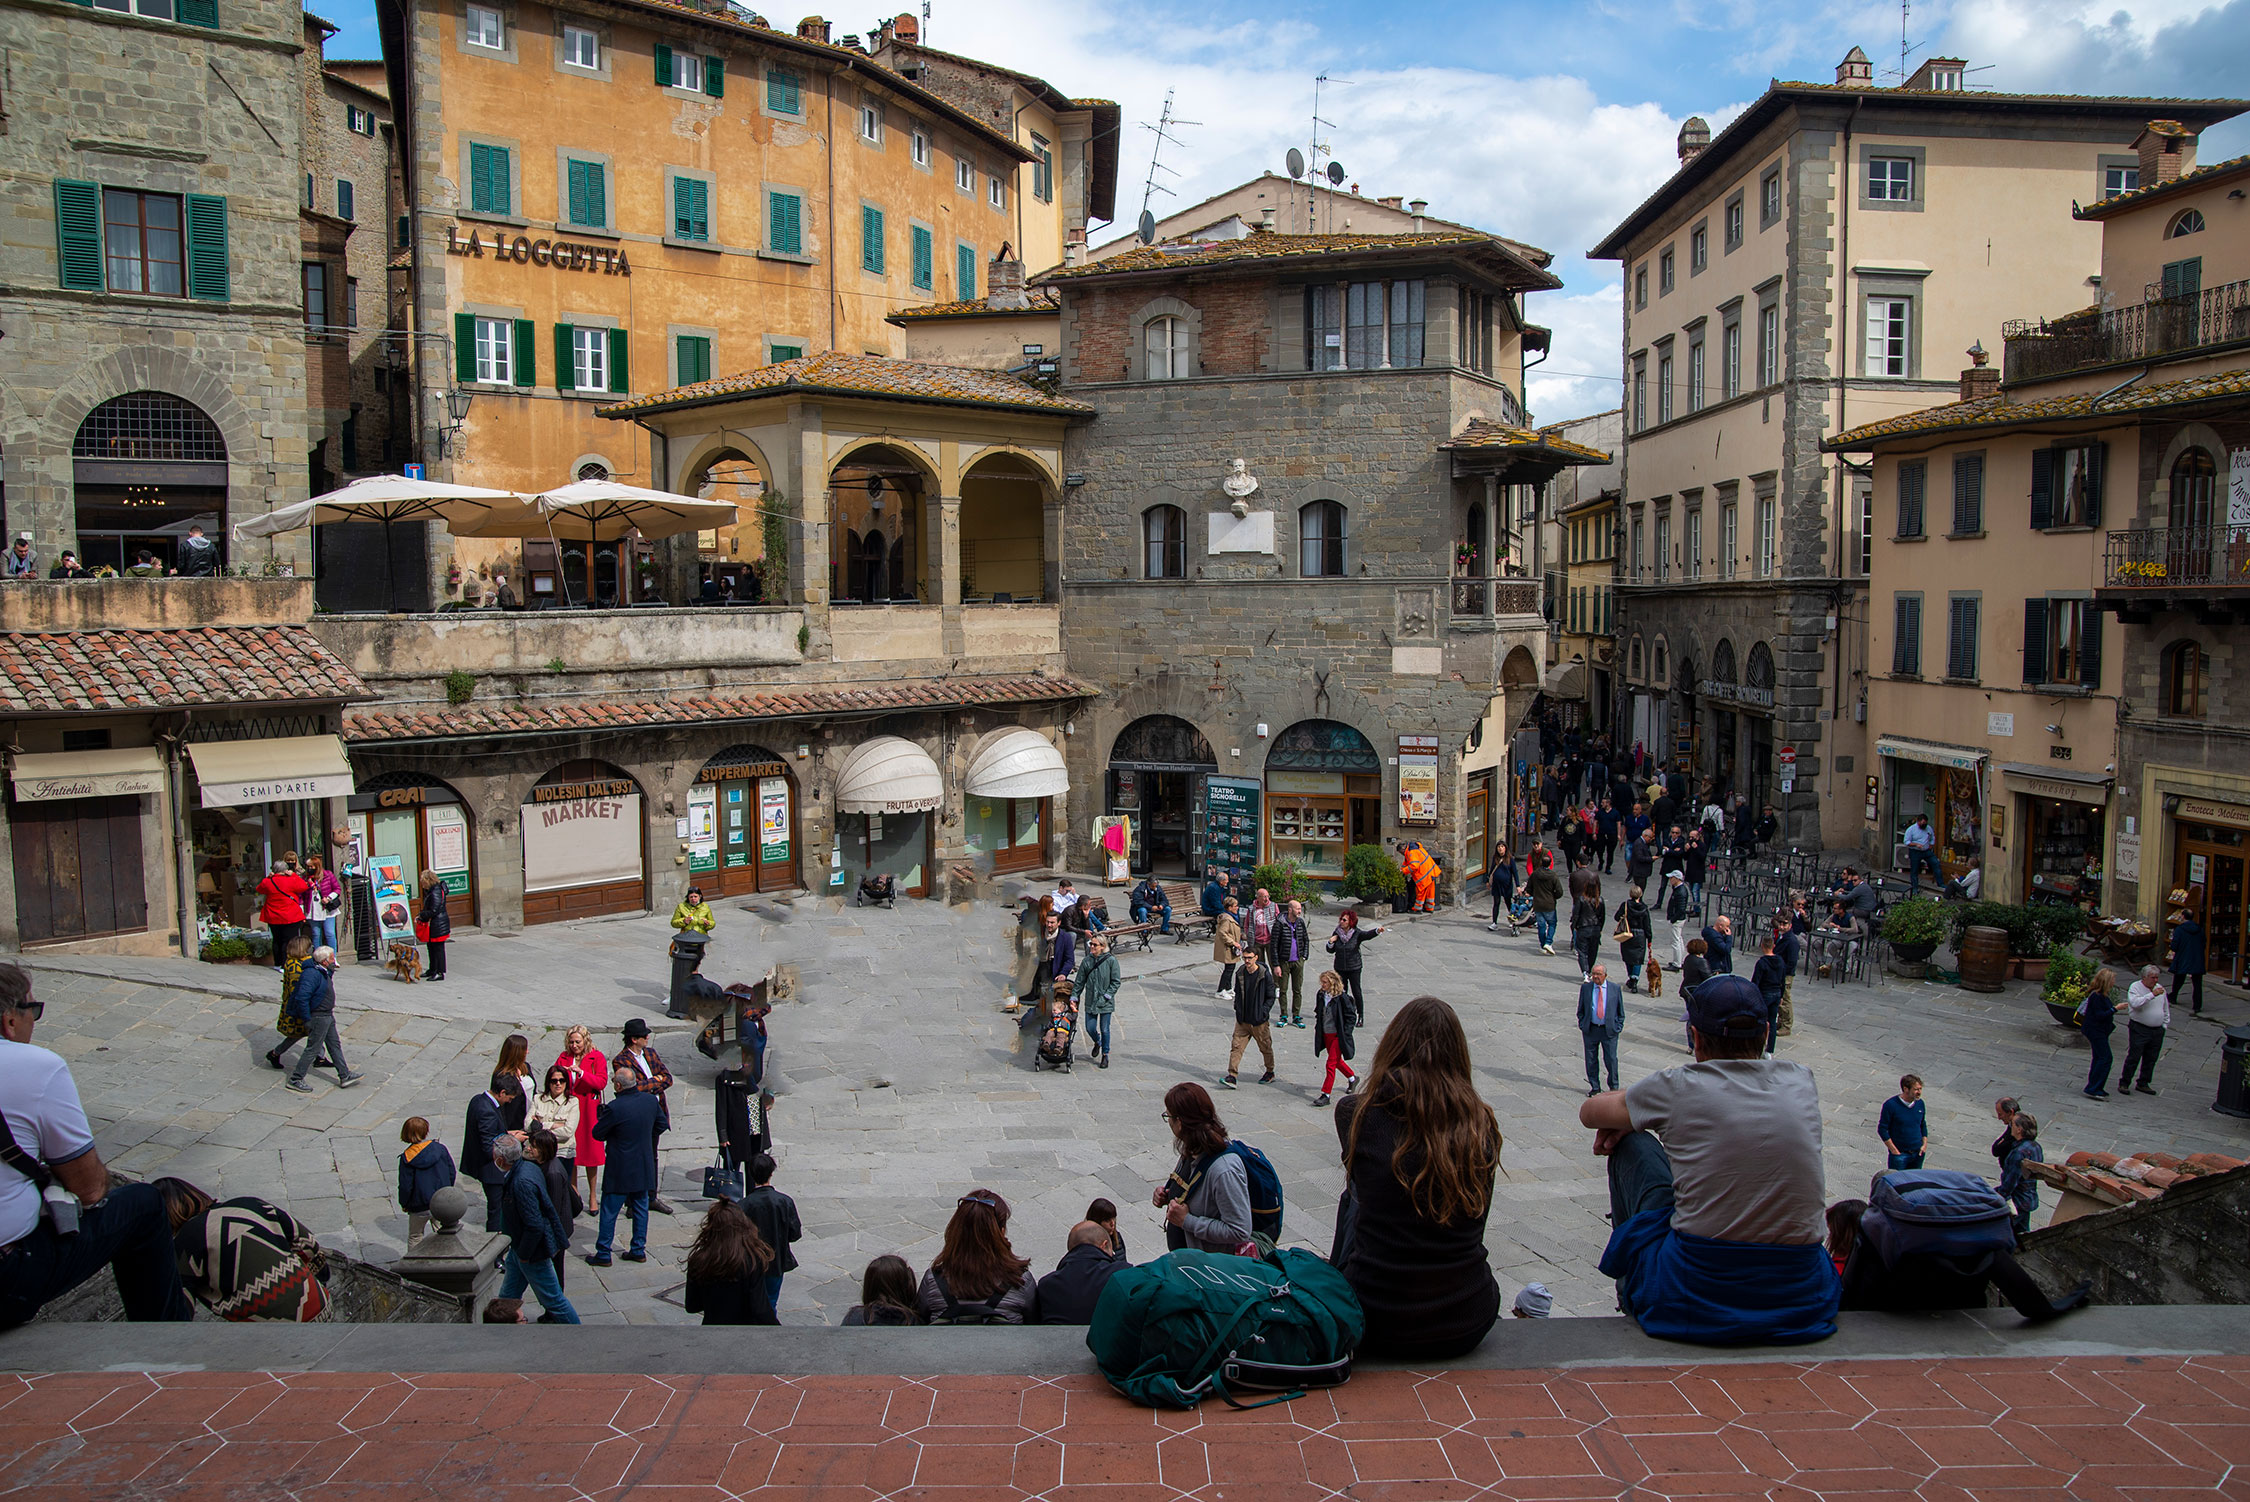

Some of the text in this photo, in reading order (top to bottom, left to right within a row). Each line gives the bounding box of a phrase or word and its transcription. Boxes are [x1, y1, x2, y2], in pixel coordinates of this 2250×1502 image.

[447, 226, 632, 277] LA LOGGETTA
[701, 762, 788, 782] SUPERMARKET
[32, 781, 93, 798] Antichità
[242, 782, 316, 798] SEMI D'ARTE
[379, 786, 426, 807] CRAI
[534, 779, 633, 802] MOLESINI DAL 1937
[1210, 793, 1246, 802] SIGNORELLI
[2030, 779, 2078, 799] Wineshop
[542, 801, 623, 828] MARKET
[886, 801, 913, 810] FRUTTA
[2186, 803, 2214, 815] Enoteca
